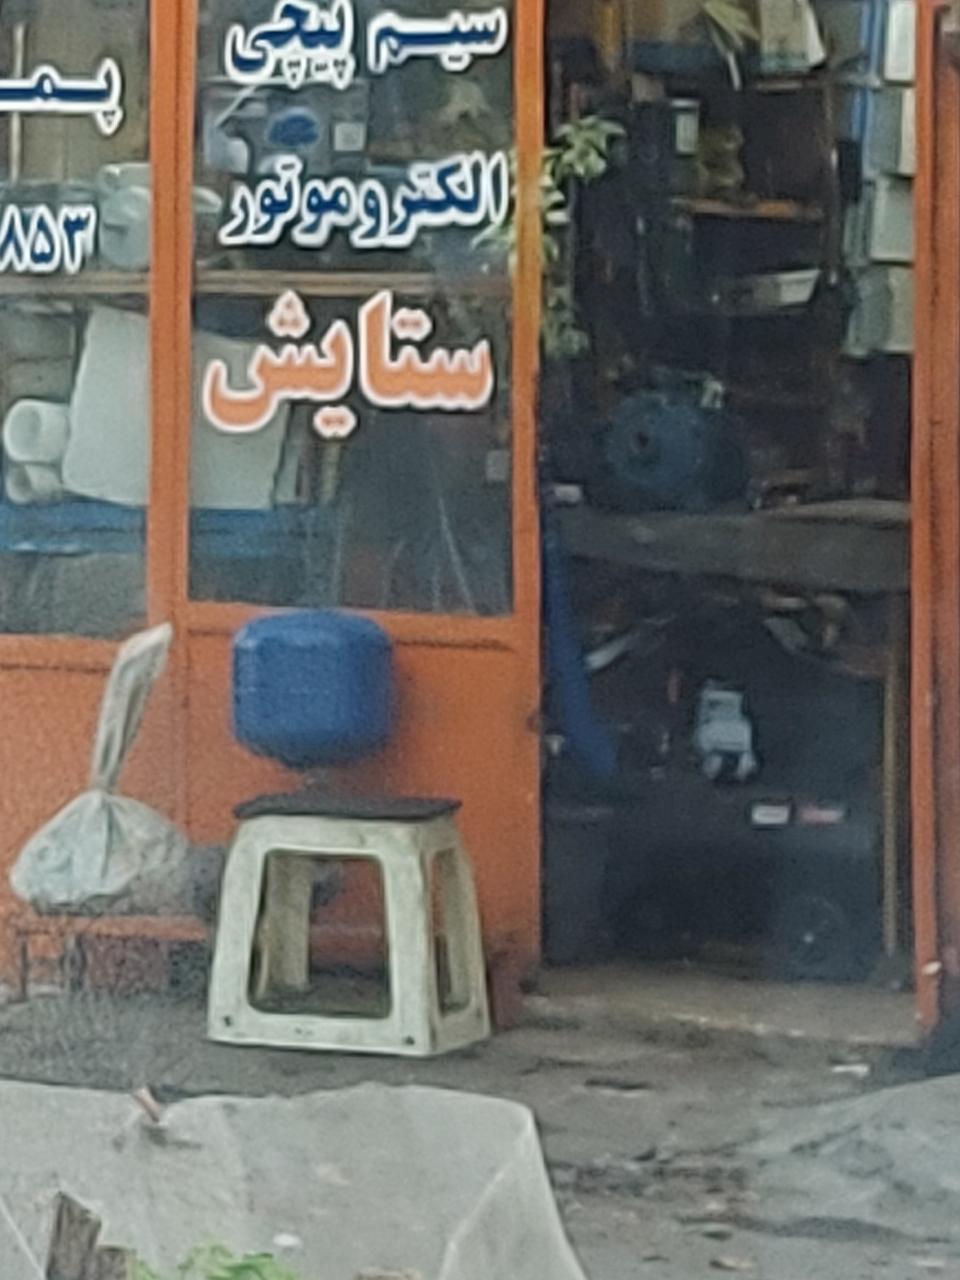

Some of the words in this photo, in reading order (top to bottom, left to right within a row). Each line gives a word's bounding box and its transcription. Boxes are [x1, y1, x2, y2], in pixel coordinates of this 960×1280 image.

[367, 6, 508, 74] سیم
[219, 150, 508, 249] الکتروموتور
[203, 290, 495, 437] ستایش
